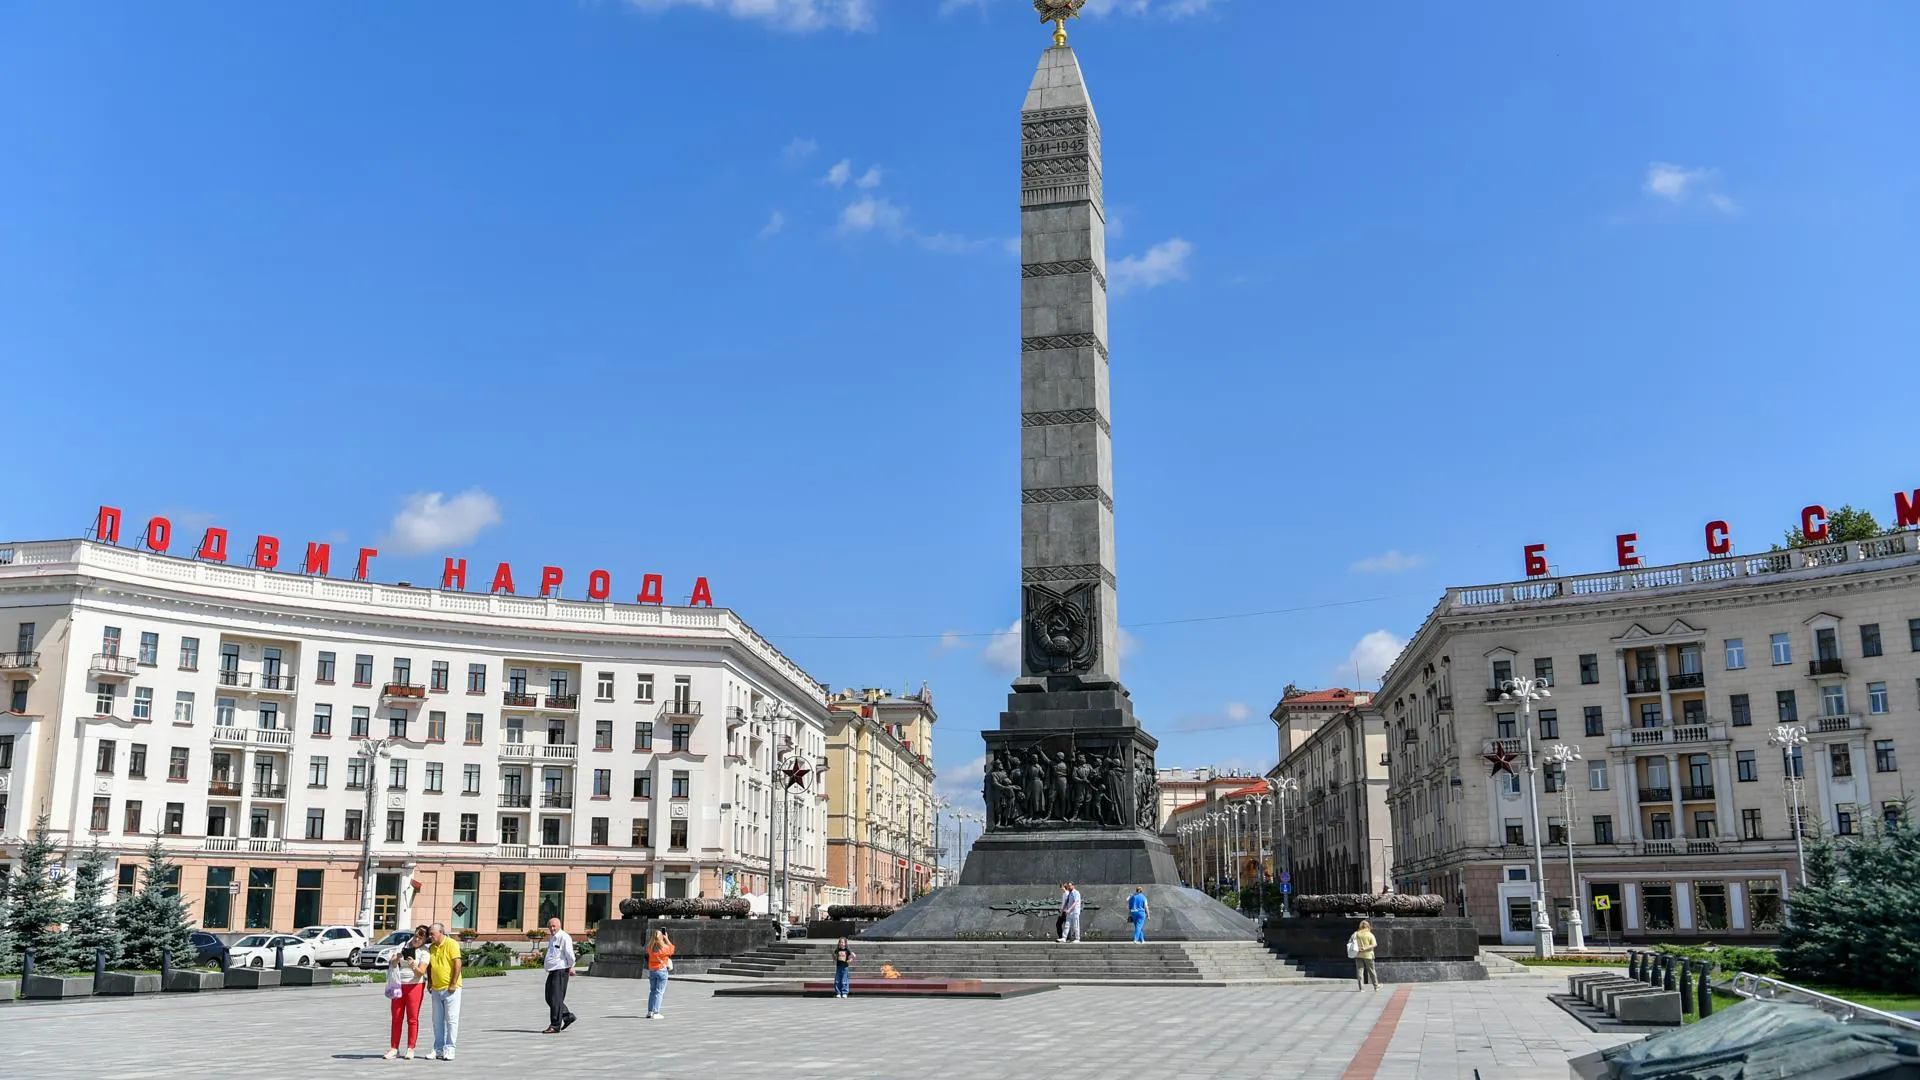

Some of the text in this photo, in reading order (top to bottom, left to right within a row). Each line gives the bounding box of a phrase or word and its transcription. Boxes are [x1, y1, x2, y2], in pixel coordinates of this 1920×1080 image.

[1025, 139, 1085, 157] 1941-1945
[97, 506, 713, 606] ПОДВИГ НАРОДА
[50, 869, 60, 879] 37
